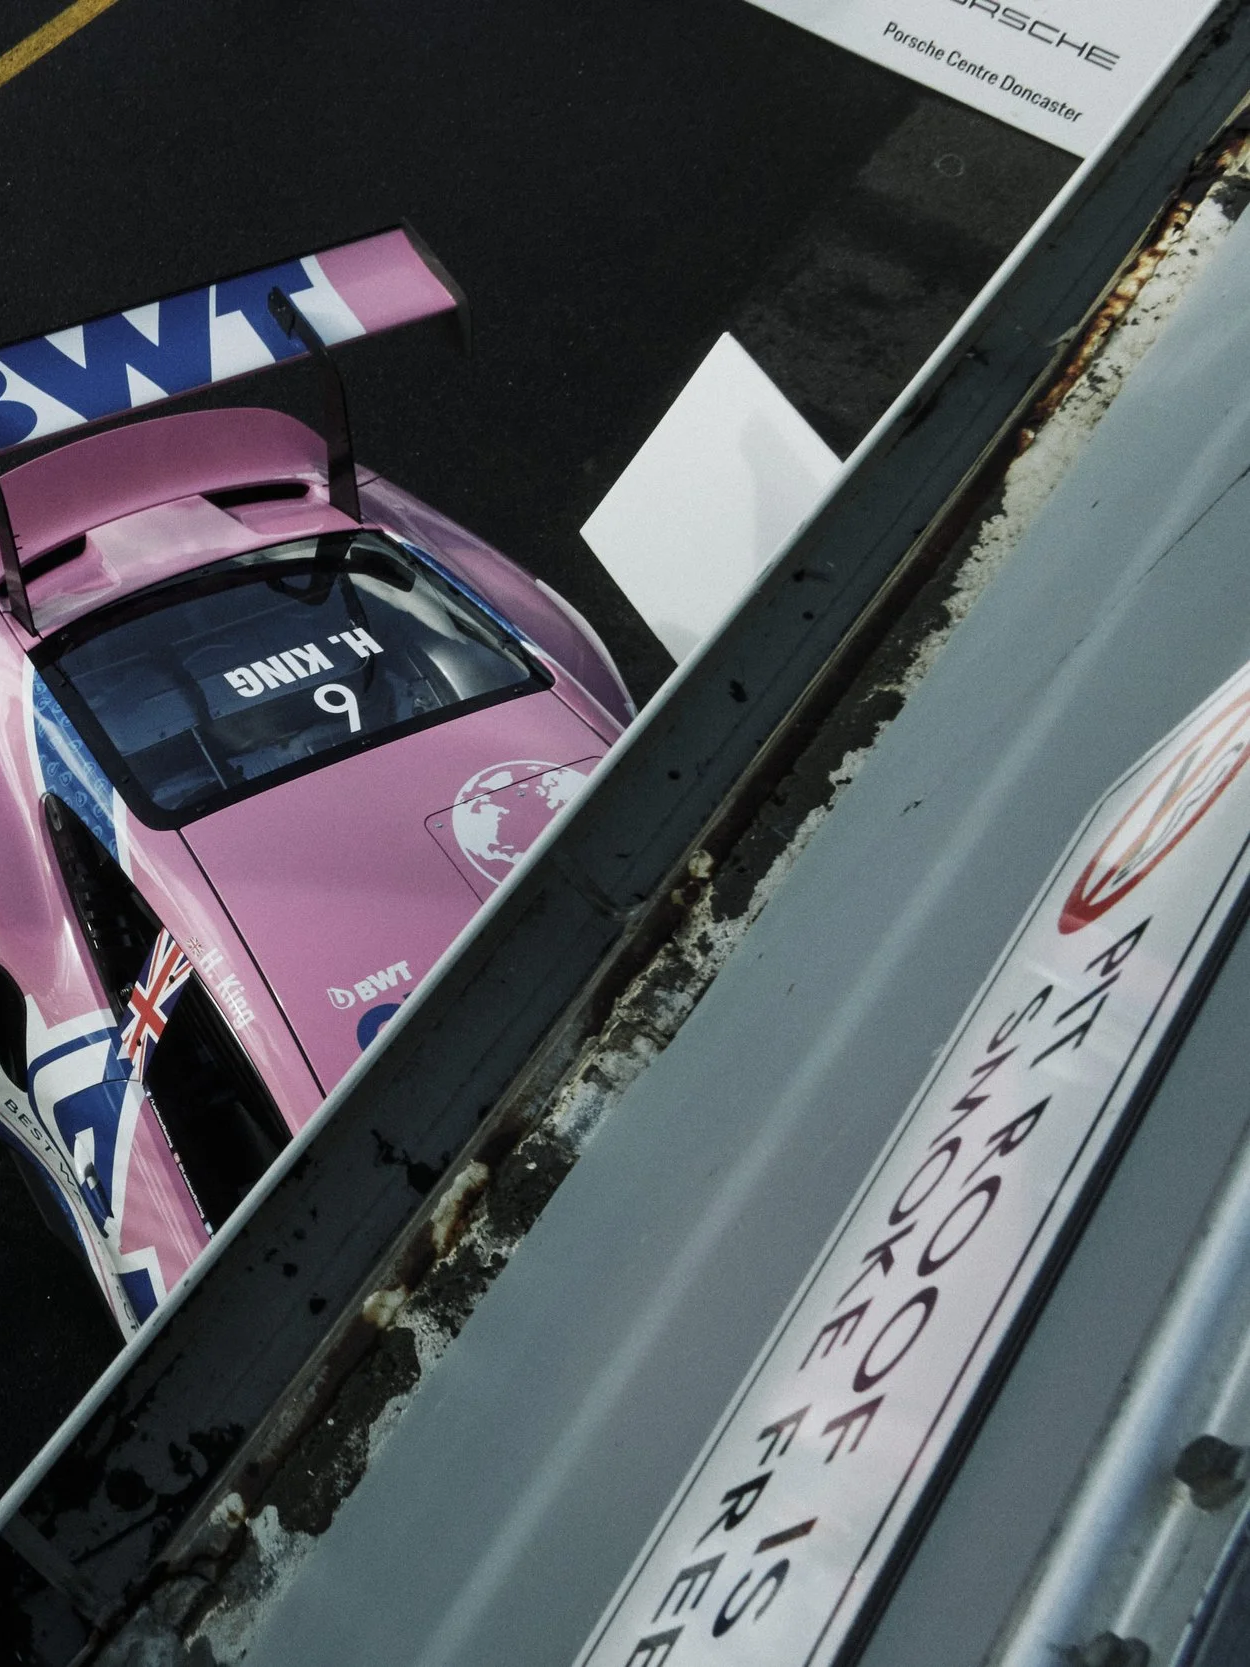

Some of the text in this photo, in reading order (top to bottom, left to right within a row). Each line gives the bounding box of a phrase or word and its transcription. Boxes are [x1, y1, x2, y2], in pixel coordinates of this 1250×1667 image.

[883, 21, 1083, 124] Porsche Centre Doncaster
[223, 627, 385, 698] H. KING
[199, 948, 255, 1031] H. King
[354, 959, 413, 1002] BWT
[4, 1098, 55, 1155] BEST
[797, 984, 1053, 1371] SMOKE
[711, 915, 1154, 1638] PIT ROOF IS
